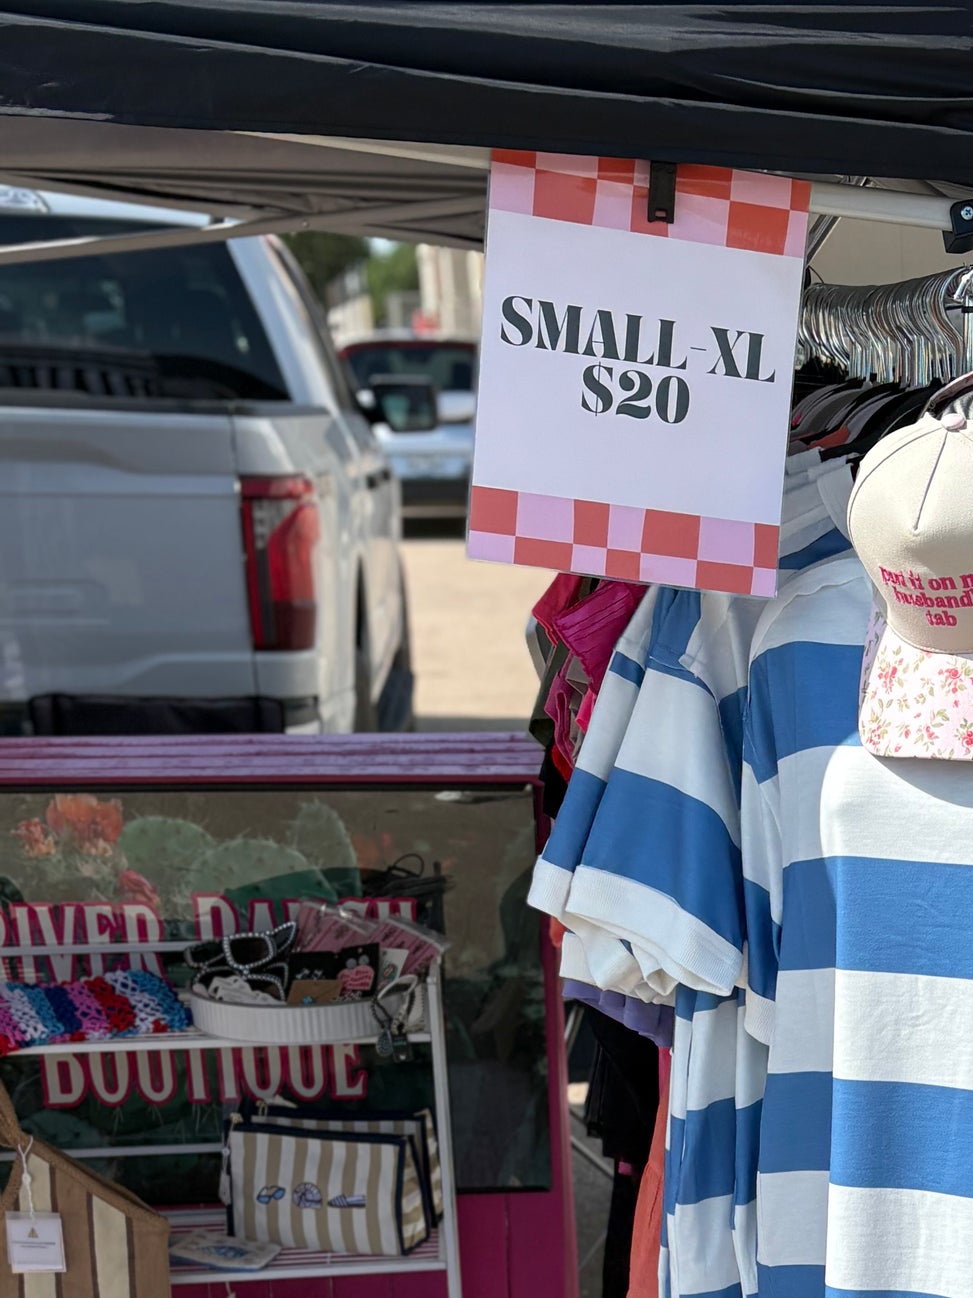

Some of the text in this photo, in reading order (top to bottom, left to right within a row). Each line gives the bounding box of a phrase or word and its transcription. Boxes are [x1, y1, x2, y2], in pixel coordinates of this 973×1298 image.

[500, 295, 776, 383] SMALL-XL
[581, 360, 690, 424] $20
[878, 566, 906, 587] put
[908, 570, 924, 590] it
[928, 575, 957, 591] on
[925, 610, 958, 627] tab
[0, 901, 165, 986] IVER
